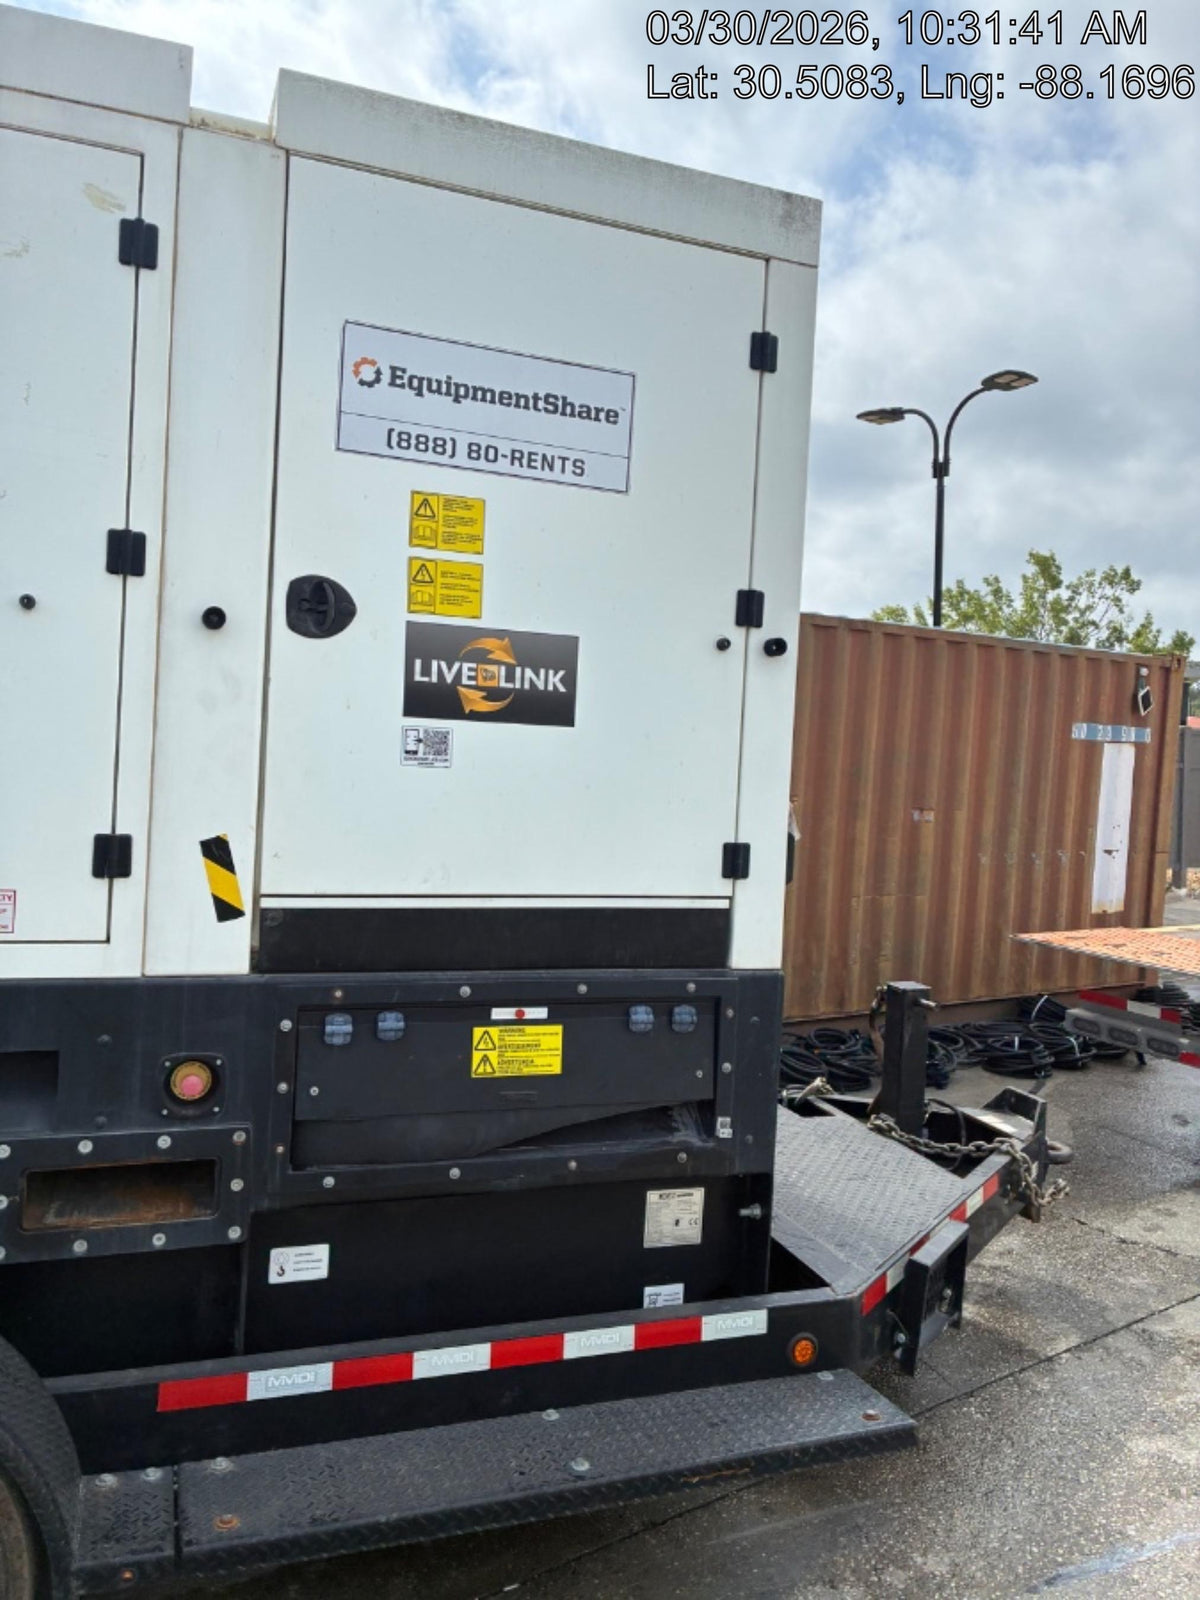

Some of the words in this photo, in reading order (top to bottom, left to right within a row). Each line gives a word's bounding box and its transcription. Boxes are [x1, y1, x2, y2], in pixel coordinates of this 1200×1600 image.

[388, 365, 620, 425] EquipmentShare
[386, 428, 457, 458] (888)
[467, 441, 586, 477] 80-RENTS
[413, 658, 478, 686] LIVE
[498, 664, 568, 693] LINK
